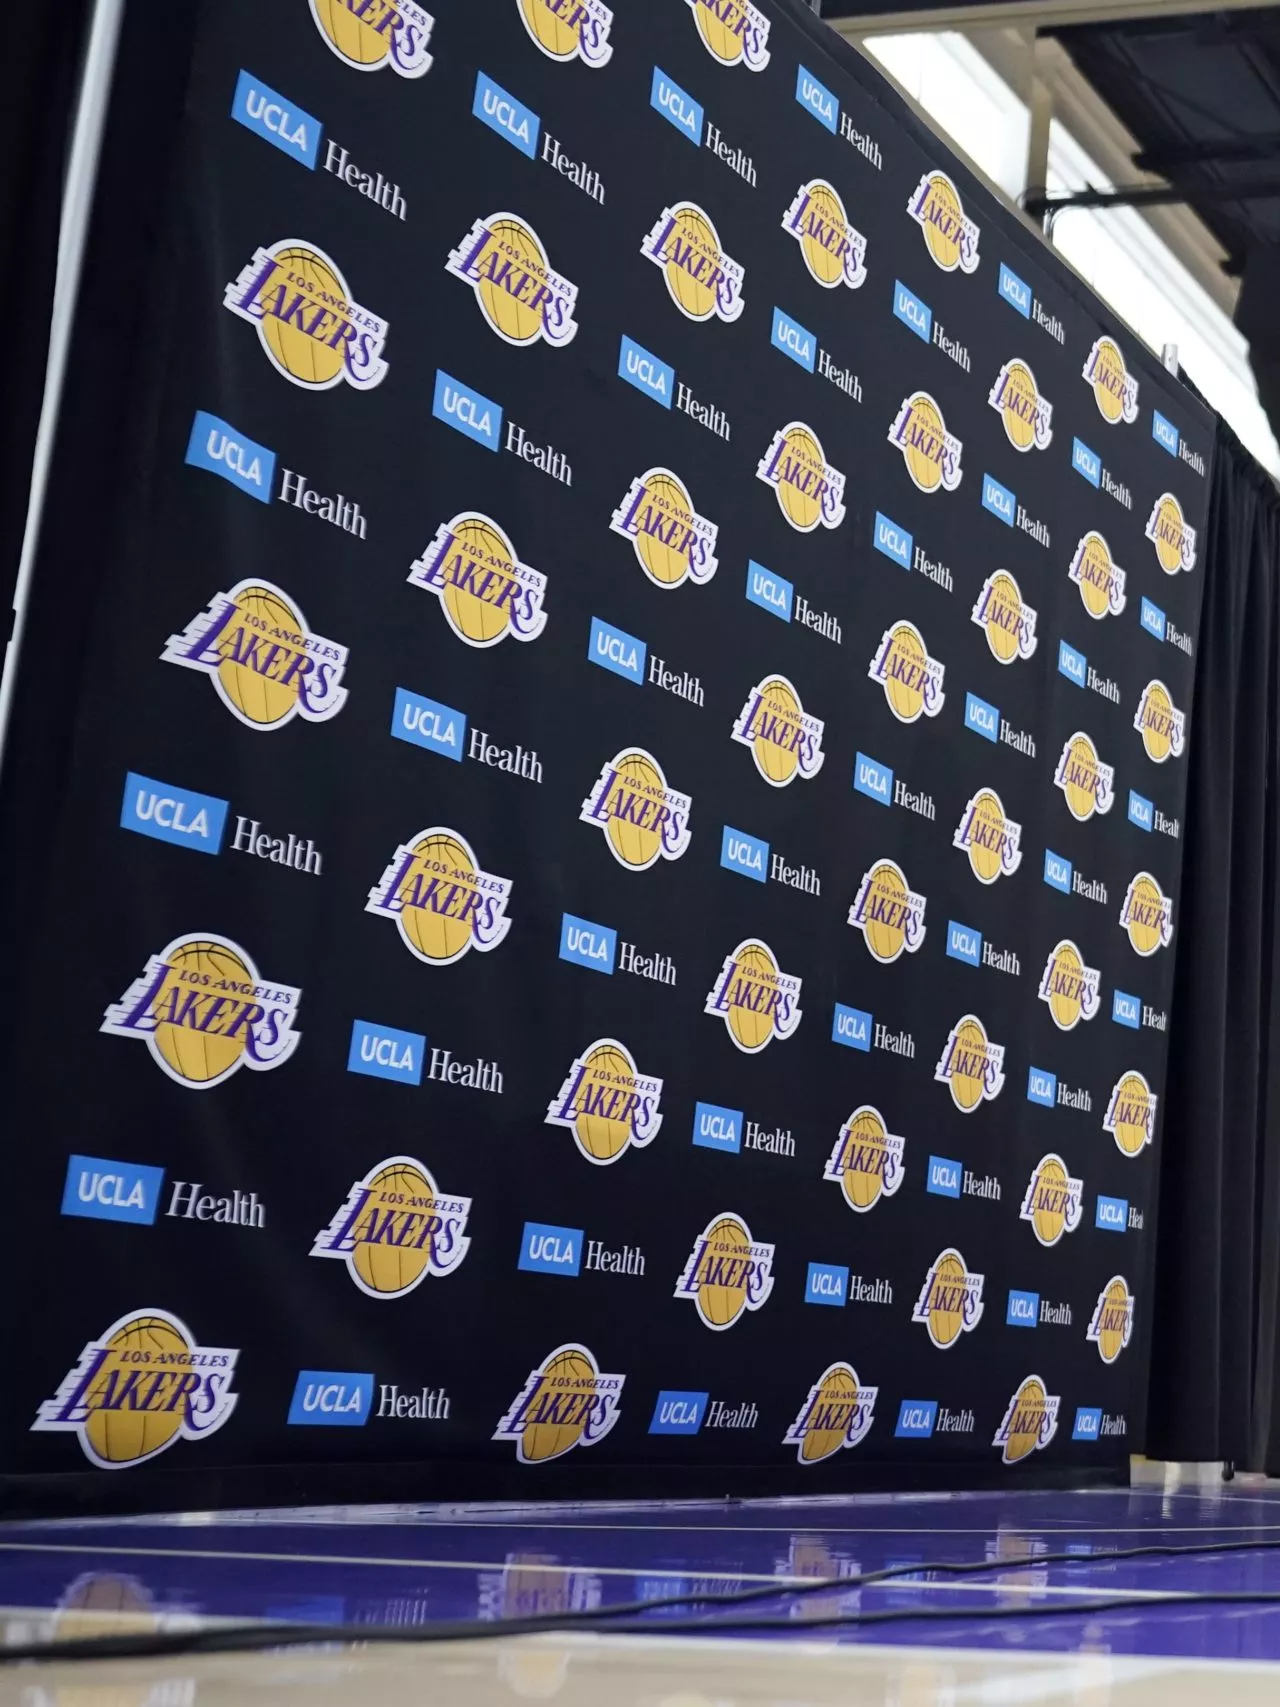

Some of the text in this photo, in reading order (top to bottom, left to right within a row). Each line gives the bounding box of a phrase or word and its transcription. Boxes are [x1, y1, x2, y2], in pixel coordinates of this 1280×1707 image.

[246, 90, 406, 221] UCLA Health
[482, 89, 604, 204] UCLA Health
[658, 82, 756, 187] UCLA Health
[802, 79, 882, 170] UCLA Health
[786, 190, 861, 283] LAKERS
[911, 180, 974, 268] LAKERS
[454, 225, 569, 340] LAKERS
[647, 213, 738, 316] LAKERS
[230, 255, 378, 382] LAKERS
[285, 271, 380, 334] LOS ANGELES
[899, 293, 970, 372] UCLA Health
[1003, 274, 1064, 345] UCLA Health
[777, 321, 862, 403] UCLA Health
[1085, 346, 1134, 418] LAKERS
[626, 350, 730, 441] UCLA Health
[992, 370, 1048, 444] LAKERS
[443, 386, 571, 486] UCLA Health
[892, 403, 957, 485] LAKERS
[1155, 421, 1204, 476] UCLA Health
[207, 430, 366, 539] UCLA Health
[761, 436, 839, 523] LAKERS
[1075, 448, 1131, 510] UCLA Health
[616, 483, 711, 578] LAKERS
[986, 485, 1050, 548] UCLA Health
[1147, 504, 1192, 566] LAKERS
[416, 530, 538, 634] LAKERS
[879, 524, 953, 592] UCLA Health
[1070, 543, 1121, 610] LAKERS
[240, 613, 339, 662] LOS ANGELES
[753, 573, 841, 644] UCLA Health
[975, 583, 1032, 653] LAKERS
[1143, 607, 1192, 656] UCLA Health
[182, 600, 336, 713] LAKERS
[597, 631, 704, 707] UCLA Health
[872, 635, 939, 710] LAKERS
[1060, 651, 1120, 704] UCLA Health
[402, 703, 542, 783] UCLA Health
[736, 692, 817, 772] LAKERS
[969, 703, 1035, 758] UCLA Health
[1134, 693, 1181, 751] LAKERS
[859, 763, 935, 820] UCLA Health
[1055, 746, 1108, 808] LAKERS
[1128, 790, 1149, 822] UCLA
[135, 790, 321, 875] UCLA Health
[586, 768, 684, 853] LAKERS
[957, 804, 1016, 869] LAKERS
[374, 851, 502, 944] LAKERS
[422, 859, 504, 894] LOS ANGELES
[728, 838, 820, 896] UCLA Health
[1046, 859, 1107, 904] UCLA Health
[851, 878, 921, 946] LAKERS
[567, 926, 676, 985] UCLA Health
[952, 931, 1020, 976] UCLA Health
[114, 961, 288, 1061] LAKERS
[180, 969, 292, 1004] LOS ANGELES
[710, 960, 794, 1033] LAKERS
[1039, 957, 1094, 1014] LAKERS
[1113, 999, 1136, 1020] UCLA
[360, 1035, 502, 1094] UCLA Health
[837, 1014, 915, 1058] UCLA Health
[938, 1034, 999, 1094] LAKERS
[553, 1064, 655, 1140] LAKERS
[1030, 1076, 1091, 1112] UCLA Health
[700, 1114, 795, 1156] UCLA Health
[828, 1128, 899, 1190] LAKERS
[78, 1171, 264, 1228] UCLA Health
[377, 1192, 465, 1214] LOS ANGELES
[932, 1166, 1001, 1200] UCLA Health
[1022, 1174, 1078, 1226] LAKERS
[1099, 1204, 1123, 1223] UCLA
[323, 1187, 462, 1268] LAKERS
[529, 1235, 645, 1275] UCLA Health
[679, 1239, 768, 1304] LAKERS
[811, 1273, 892, 1304] UCLA Health
[916, 1272, 978, 1325] LAKERS
[1010, 1299, 1071, 1325] UCLA Health
[46, 1348, 226, 1430] LAKERS
[117, 1351, 231, 1367] LOS ANGELES
[303, 1384, 449, 1419] UCLA Health
[500, 1375, 615, 1439] LAKERS
[659, 1401, 758, 1428] UCLA Health
[789, 1389, 870, 1442] LAKERS
[902, 1408, 974, 1432] UCLA Health
[996, 1398, 1054, 1444] LAKERS
